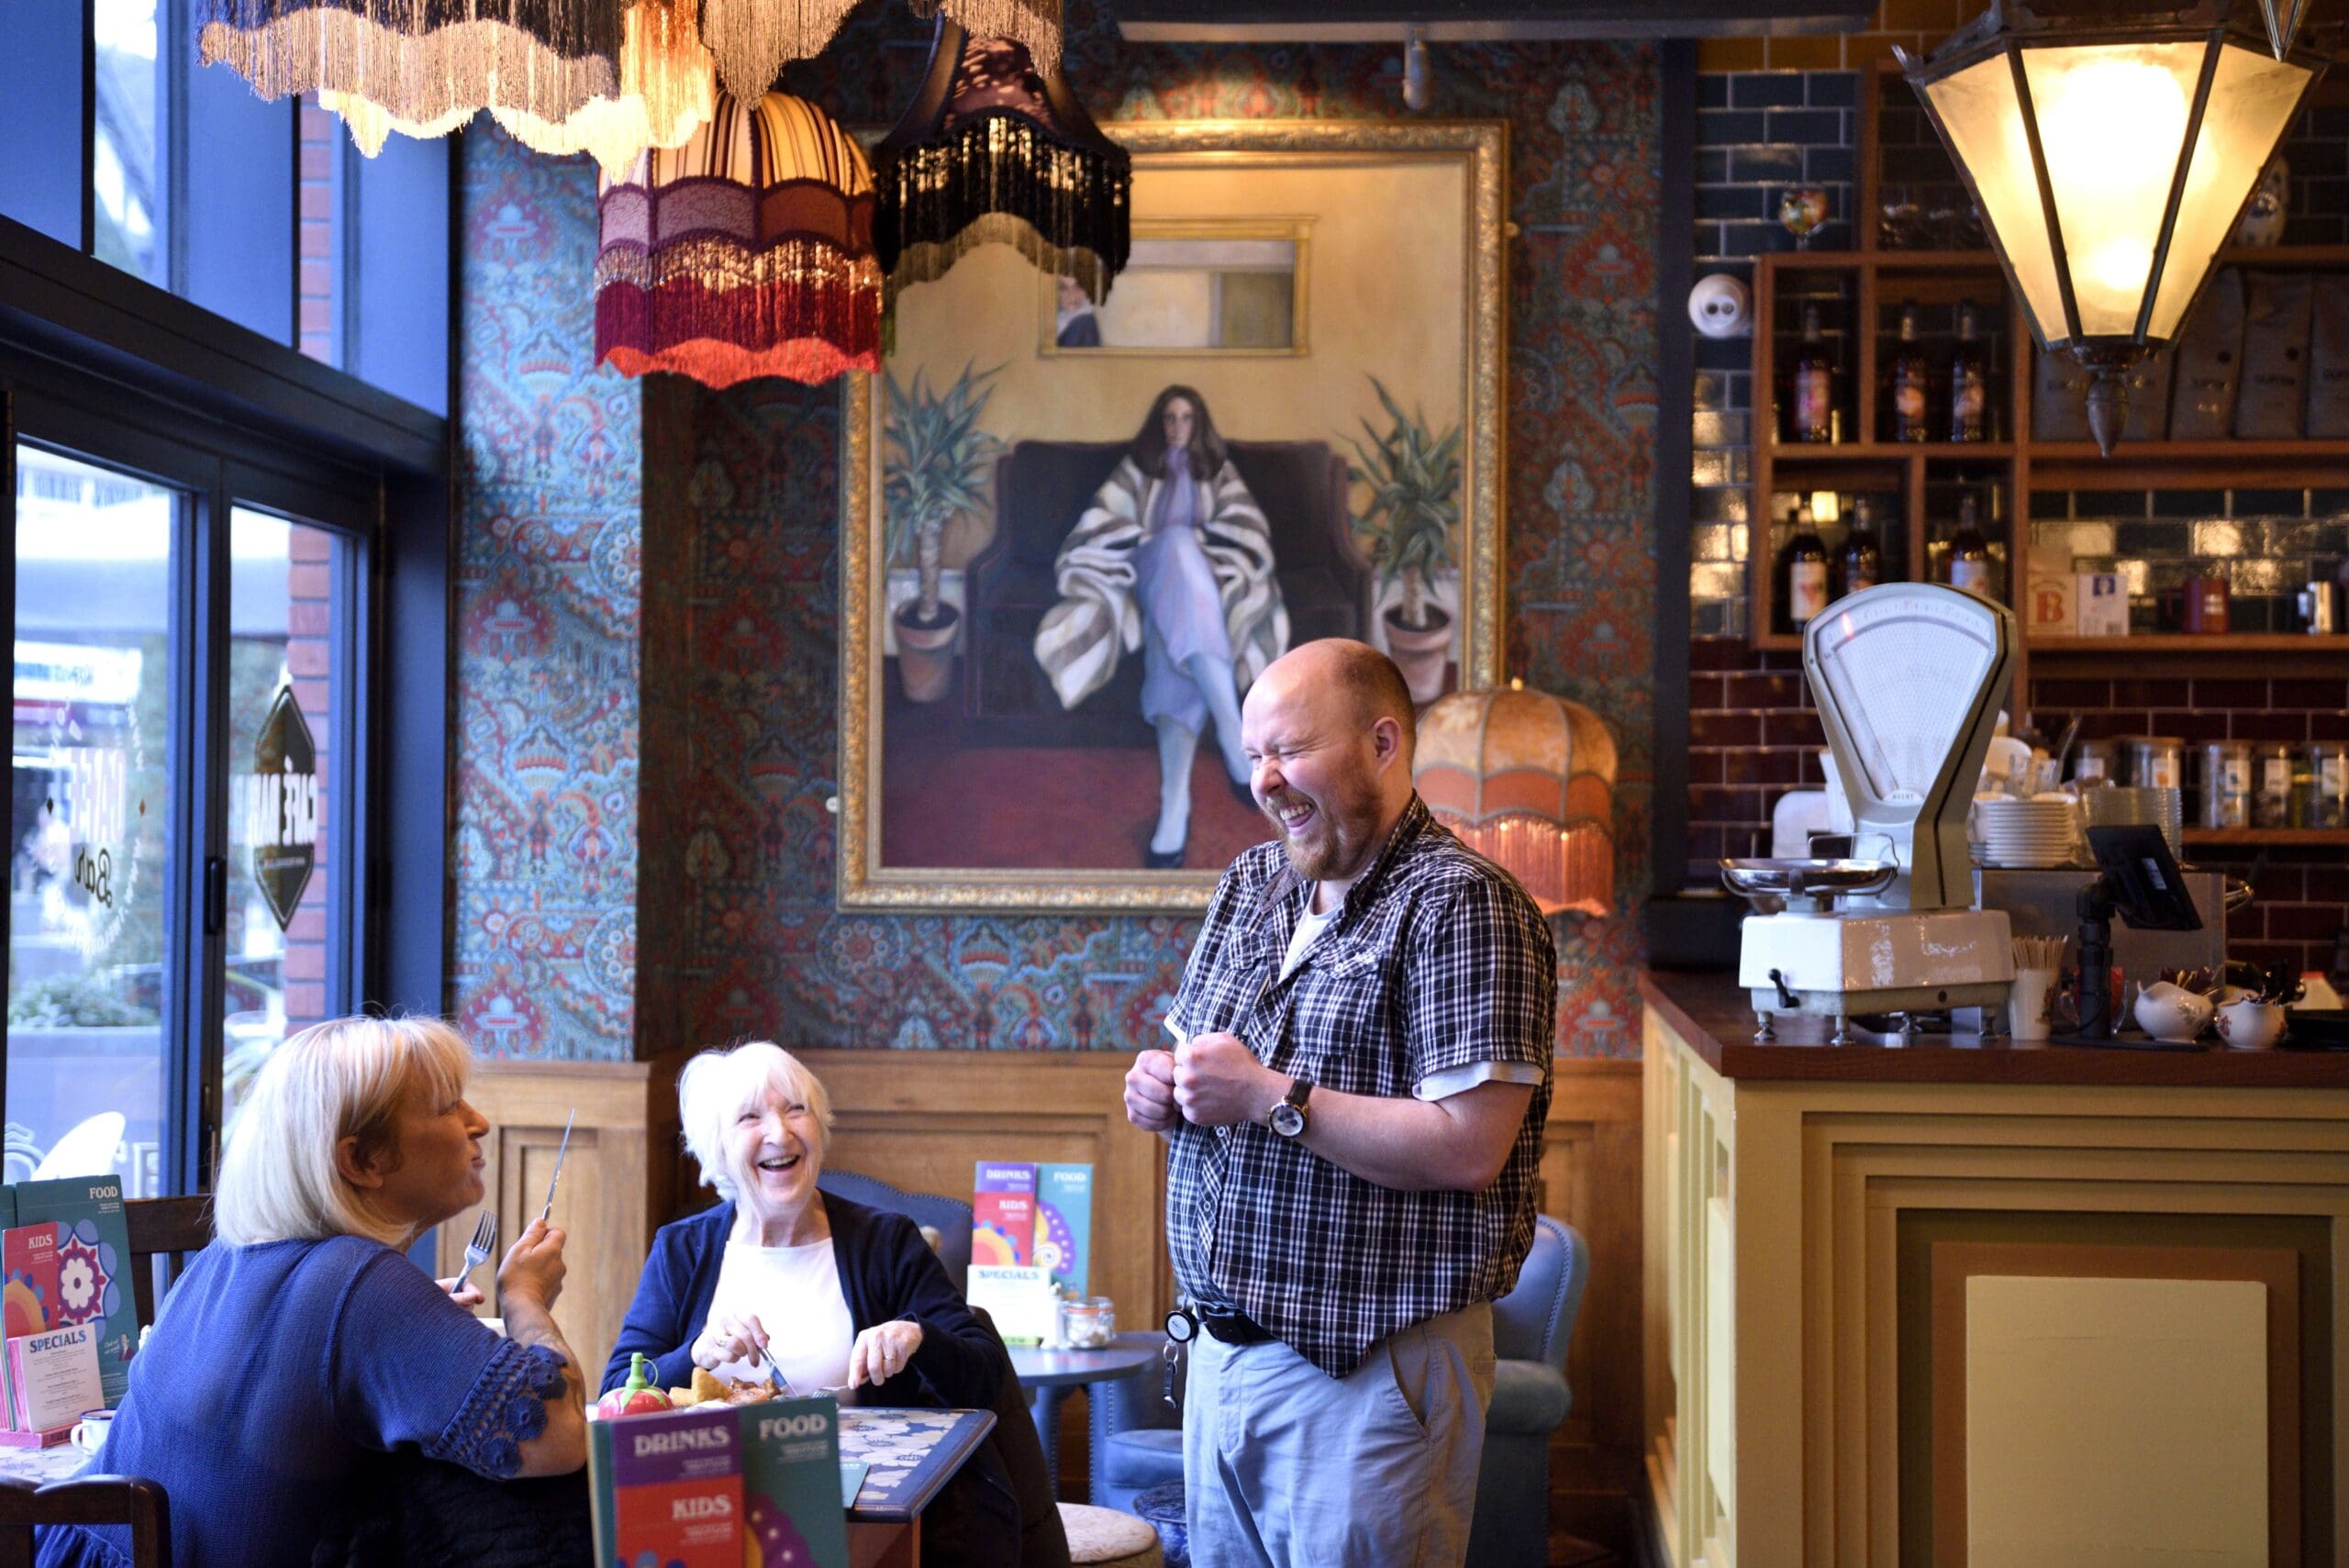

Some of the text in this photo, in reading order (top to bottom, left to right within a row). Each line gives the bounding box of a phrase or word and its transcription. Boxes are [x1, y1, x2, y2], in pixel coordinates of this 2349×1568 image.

[986, 1169, 1031, 1181] DRINKS
[1053, 1172, 1086, 1182] FOOD
[89, 1185, 118, 1199] FOOD
[999, 1199, 1028, 1210] KIDS
[28, 1234, 53, 1249] KIDS
[978, 1270, 1041, 1281] SPECIALS
[29, 1330, 86, 1353] SPECIALS
[758, 1414, 827, 1440] FOOD
[634, 1426, 730, 1457] DRINKS
[672, 1495, 732, 1521] KIDS
